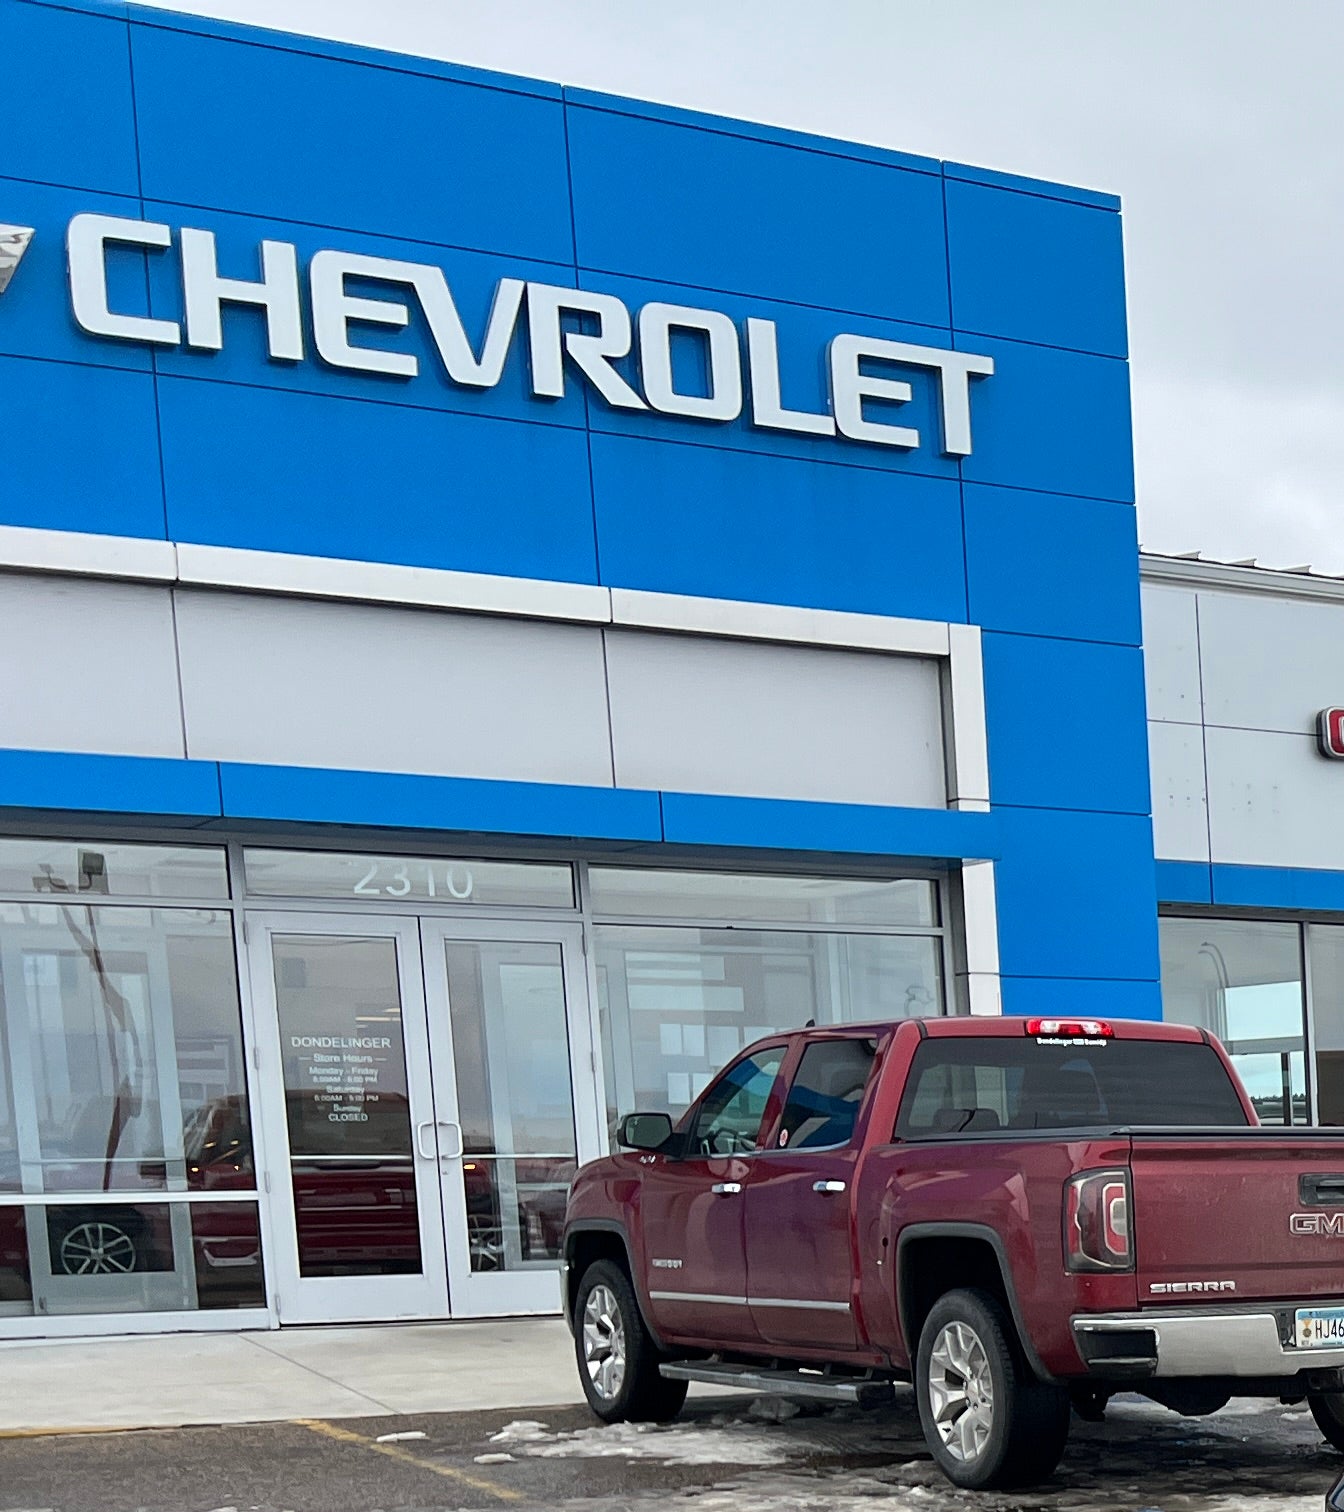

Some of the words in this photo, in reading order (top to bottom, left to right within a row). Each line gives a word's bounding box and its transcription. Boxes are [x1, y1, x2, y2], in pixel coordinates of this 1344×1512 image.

[66, 212, 995, 456] CHEVROLET
[354, 863, 473, 899] 2310
[291, 1036, 392, 1049] DONDELINGER
[309, 1066, 344, 1076] Monday
[351, 1067, 379, 1079] Friday
[328, 1113, 369, 1122] CLOSED
[1150, 1281, 1236, 1294] SIERRA
